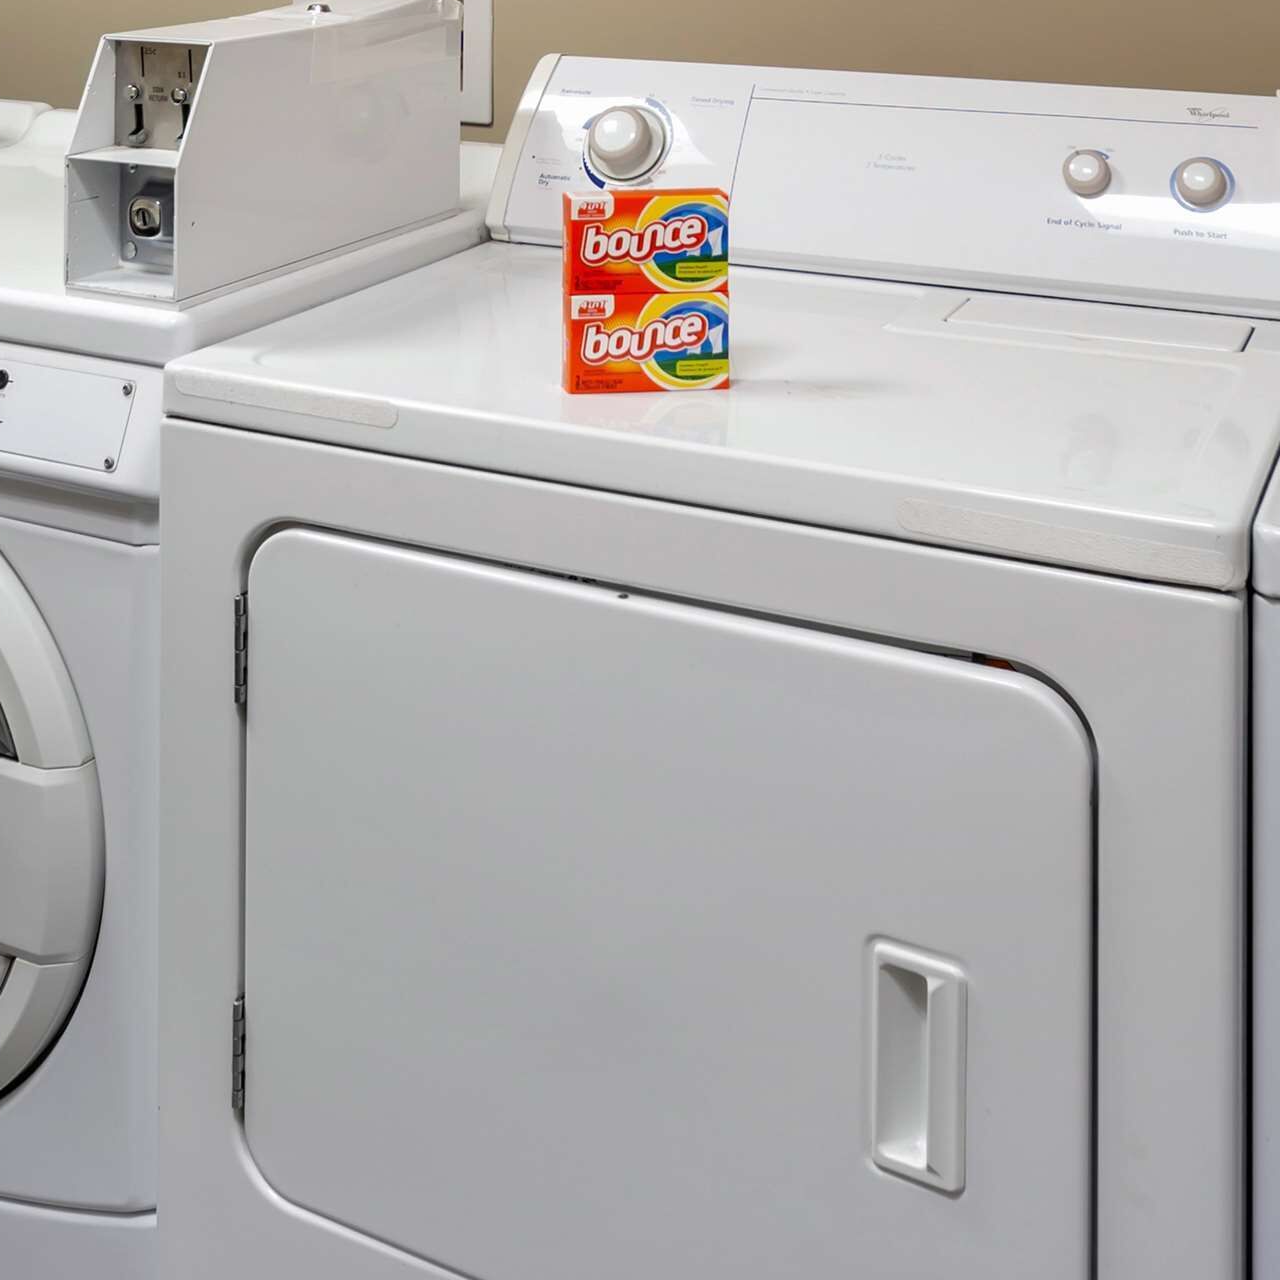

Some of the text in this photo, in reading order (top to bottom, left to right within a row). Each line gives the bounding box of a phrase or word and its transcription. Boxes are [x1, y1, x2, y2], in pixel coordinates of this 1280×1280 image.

[582, 216, 705, 263] bounce
[1046, 217, 1122, 232] End of Cycle Signal
[1173, 228, 1192, 237] Push
[1207, 231, 1227, 239] Start
[582, 313, 706, 362] bounce
